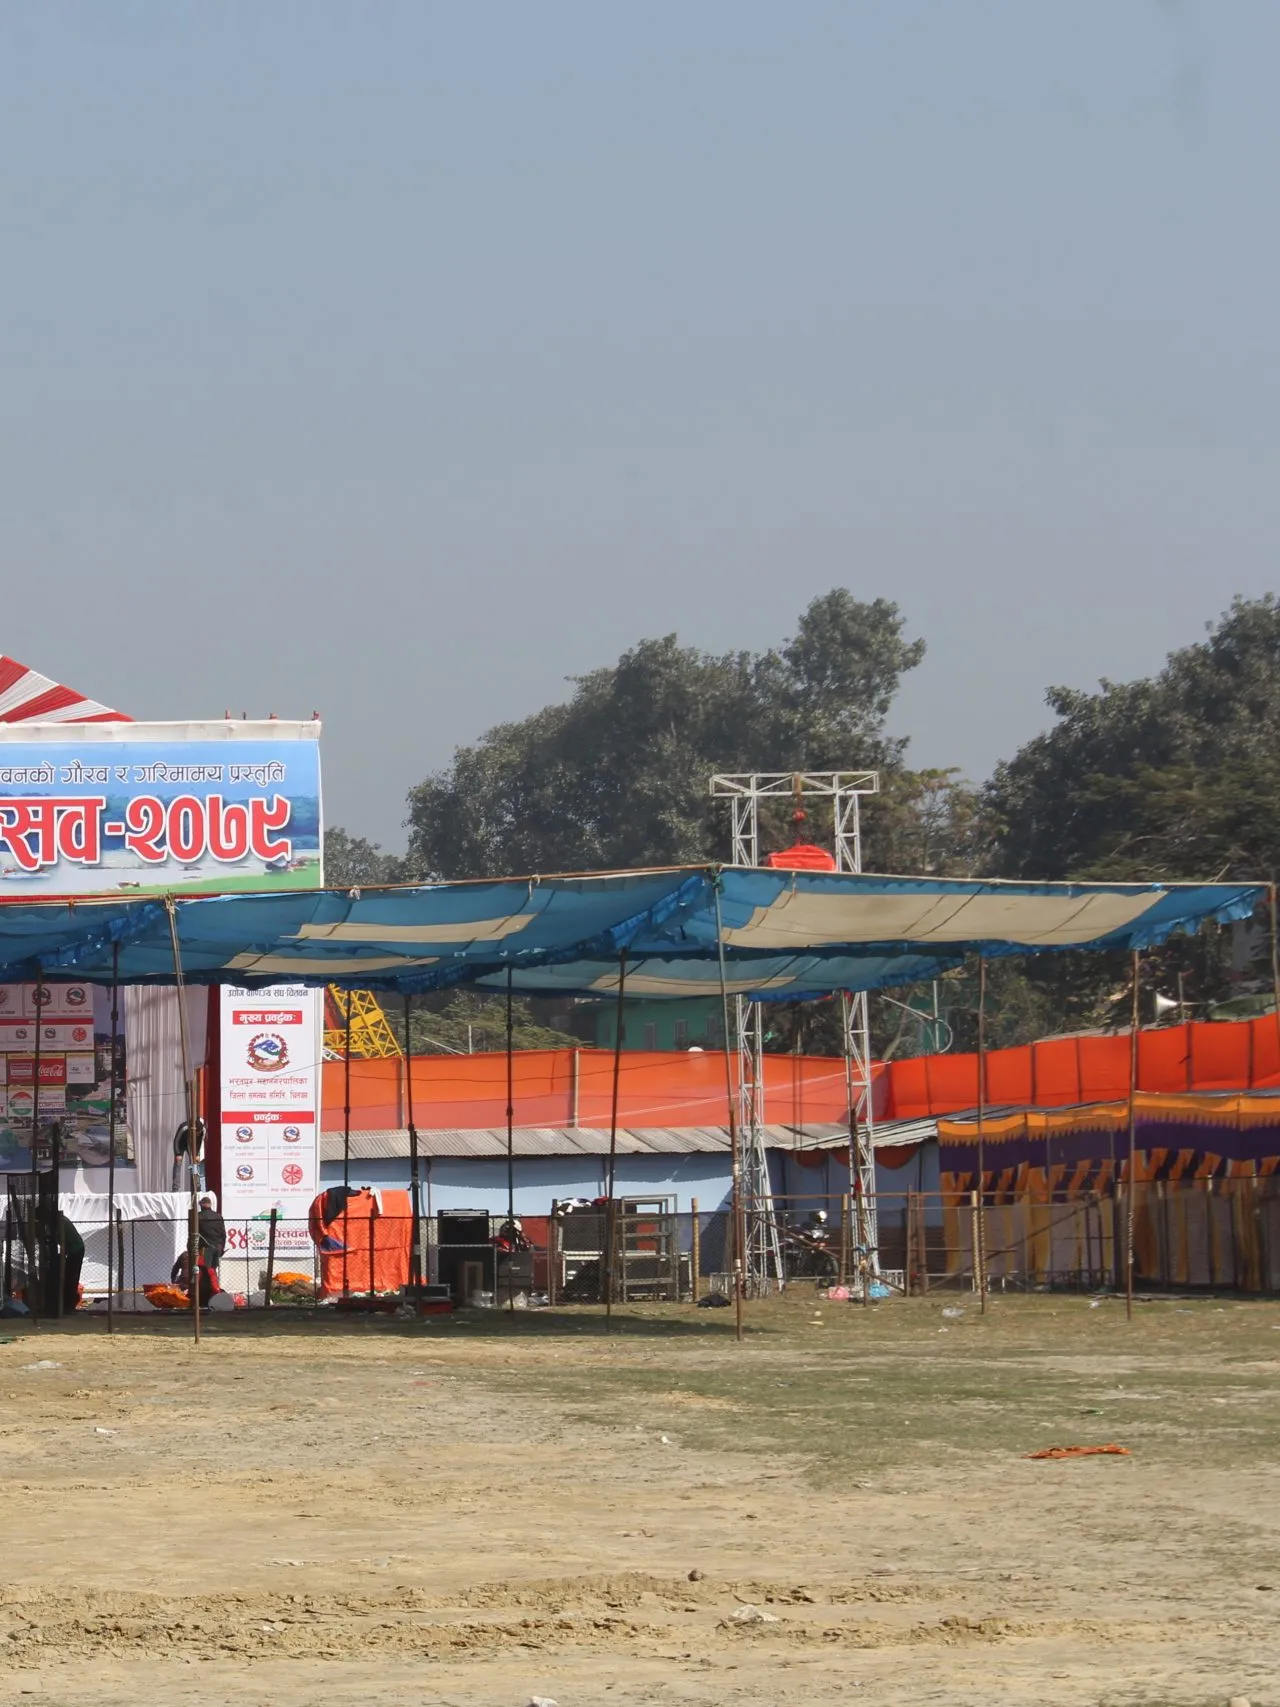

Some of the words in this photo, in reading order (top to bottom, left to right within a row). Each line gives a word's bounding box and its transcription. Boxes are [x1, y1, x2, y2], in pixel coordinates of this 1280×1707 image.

[62, 760, 108, 784] गौरव
[115, 765, 130, 784] र
[135, 762, 221, 784] गरिमामय
[228, 761, 286, 787] प्रस्तुति
[286, 987, 309, 997] चितवन
[239, 1013, 261, 1023] मुख्य
[229, 1077, 253, 1087] भरतपुर
[257, 1075, 308, 1085] महानगरपालिका
